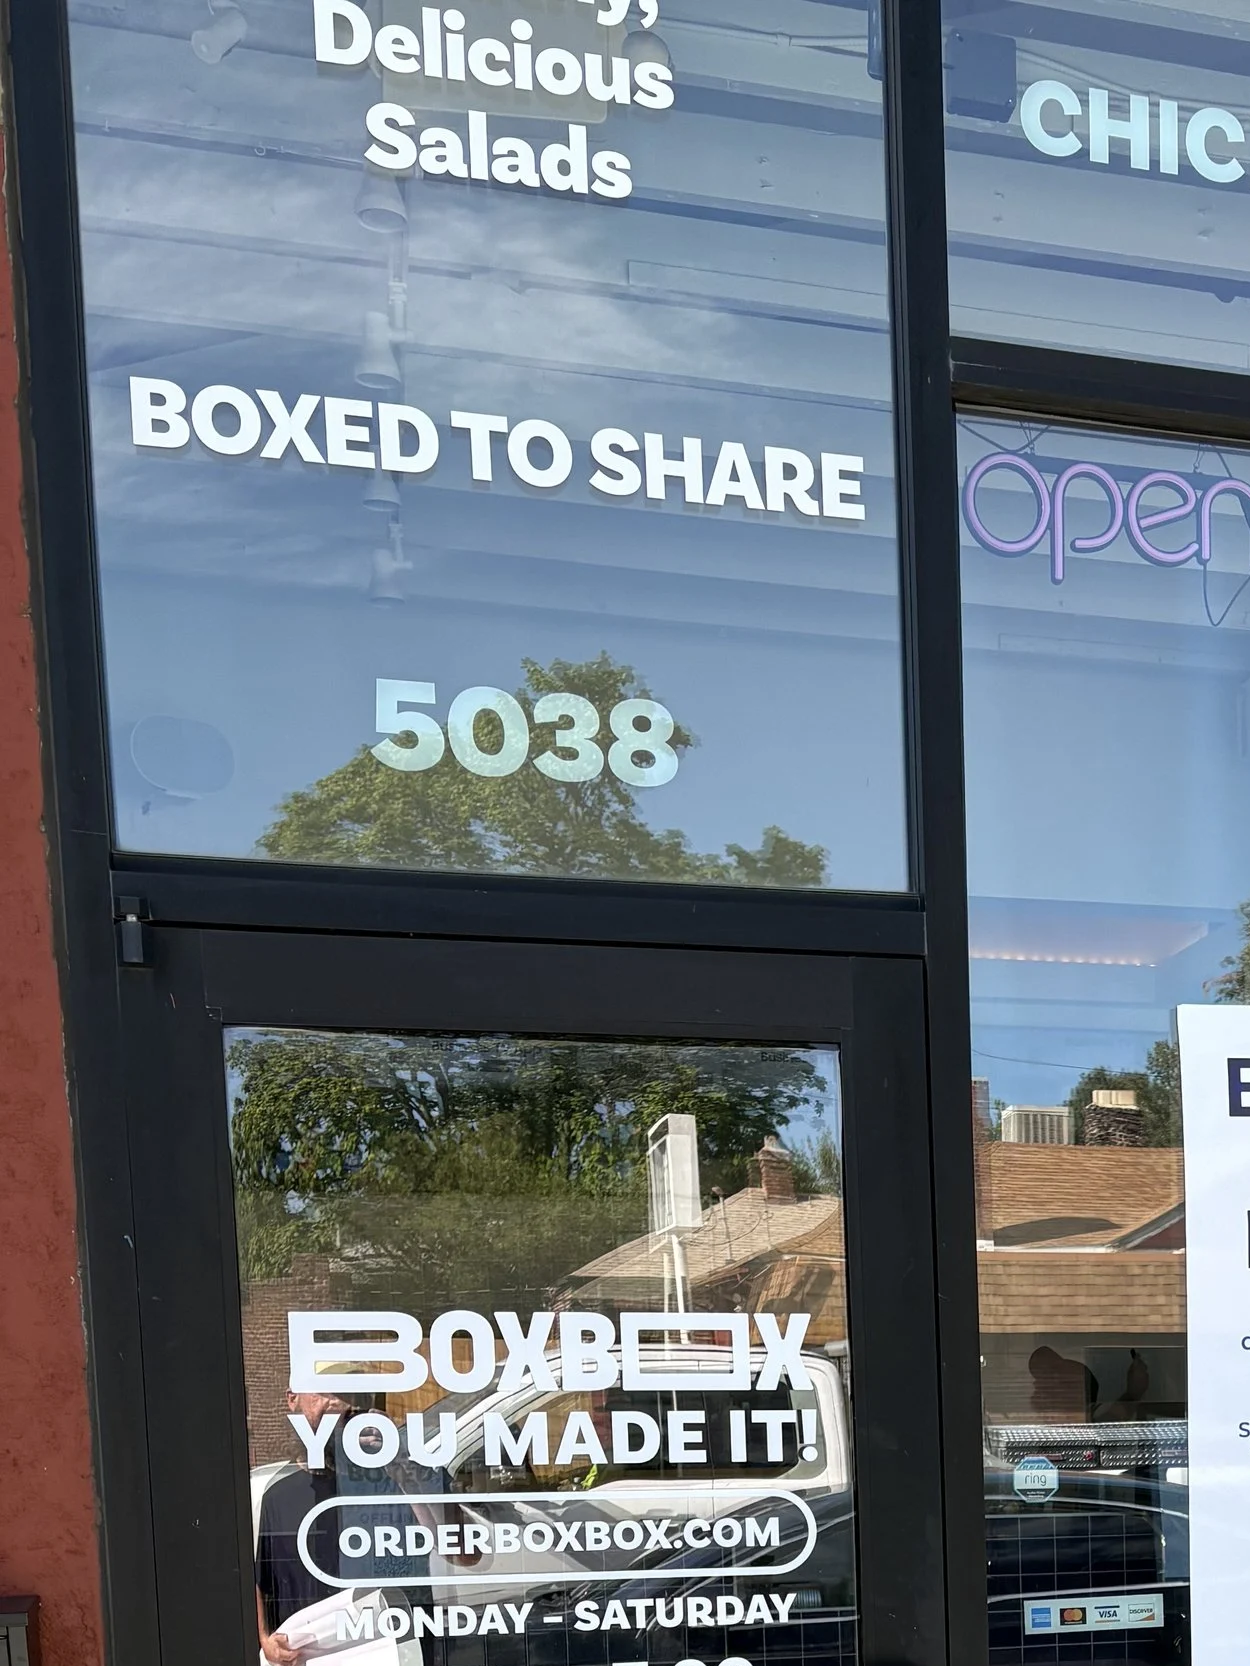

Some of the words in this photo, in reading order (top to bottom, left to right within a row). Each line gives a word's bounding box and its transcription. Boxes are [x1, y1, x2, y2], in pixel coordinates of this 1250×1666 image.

[313, 0, 675, 110] Delicious
[364, 102, 633, 199] Salads
[129, 376, 440, 474] BOXED
[450, 410, 573, 489] TO
[589, 428, 865, 521] SHARE
[371, 678, 679, 788] 5038
[288, 1310, 814, 1392] BOXBOX
[287, 1412, 458, 1469] YOU
[483, 1411, 706, 1466] MADE
[729, 1409, 819, 1464] IT!
[1024, 1472, 1047, 1487] ring
[339, 1517, 780, 1559] ORDERBOXBOX.COM
[336, 1603, 534, 1641] MONDAY
[573, 1593, 797, 1632] SATURDAY
[1098, 1609, 1118, 1619] VISA
